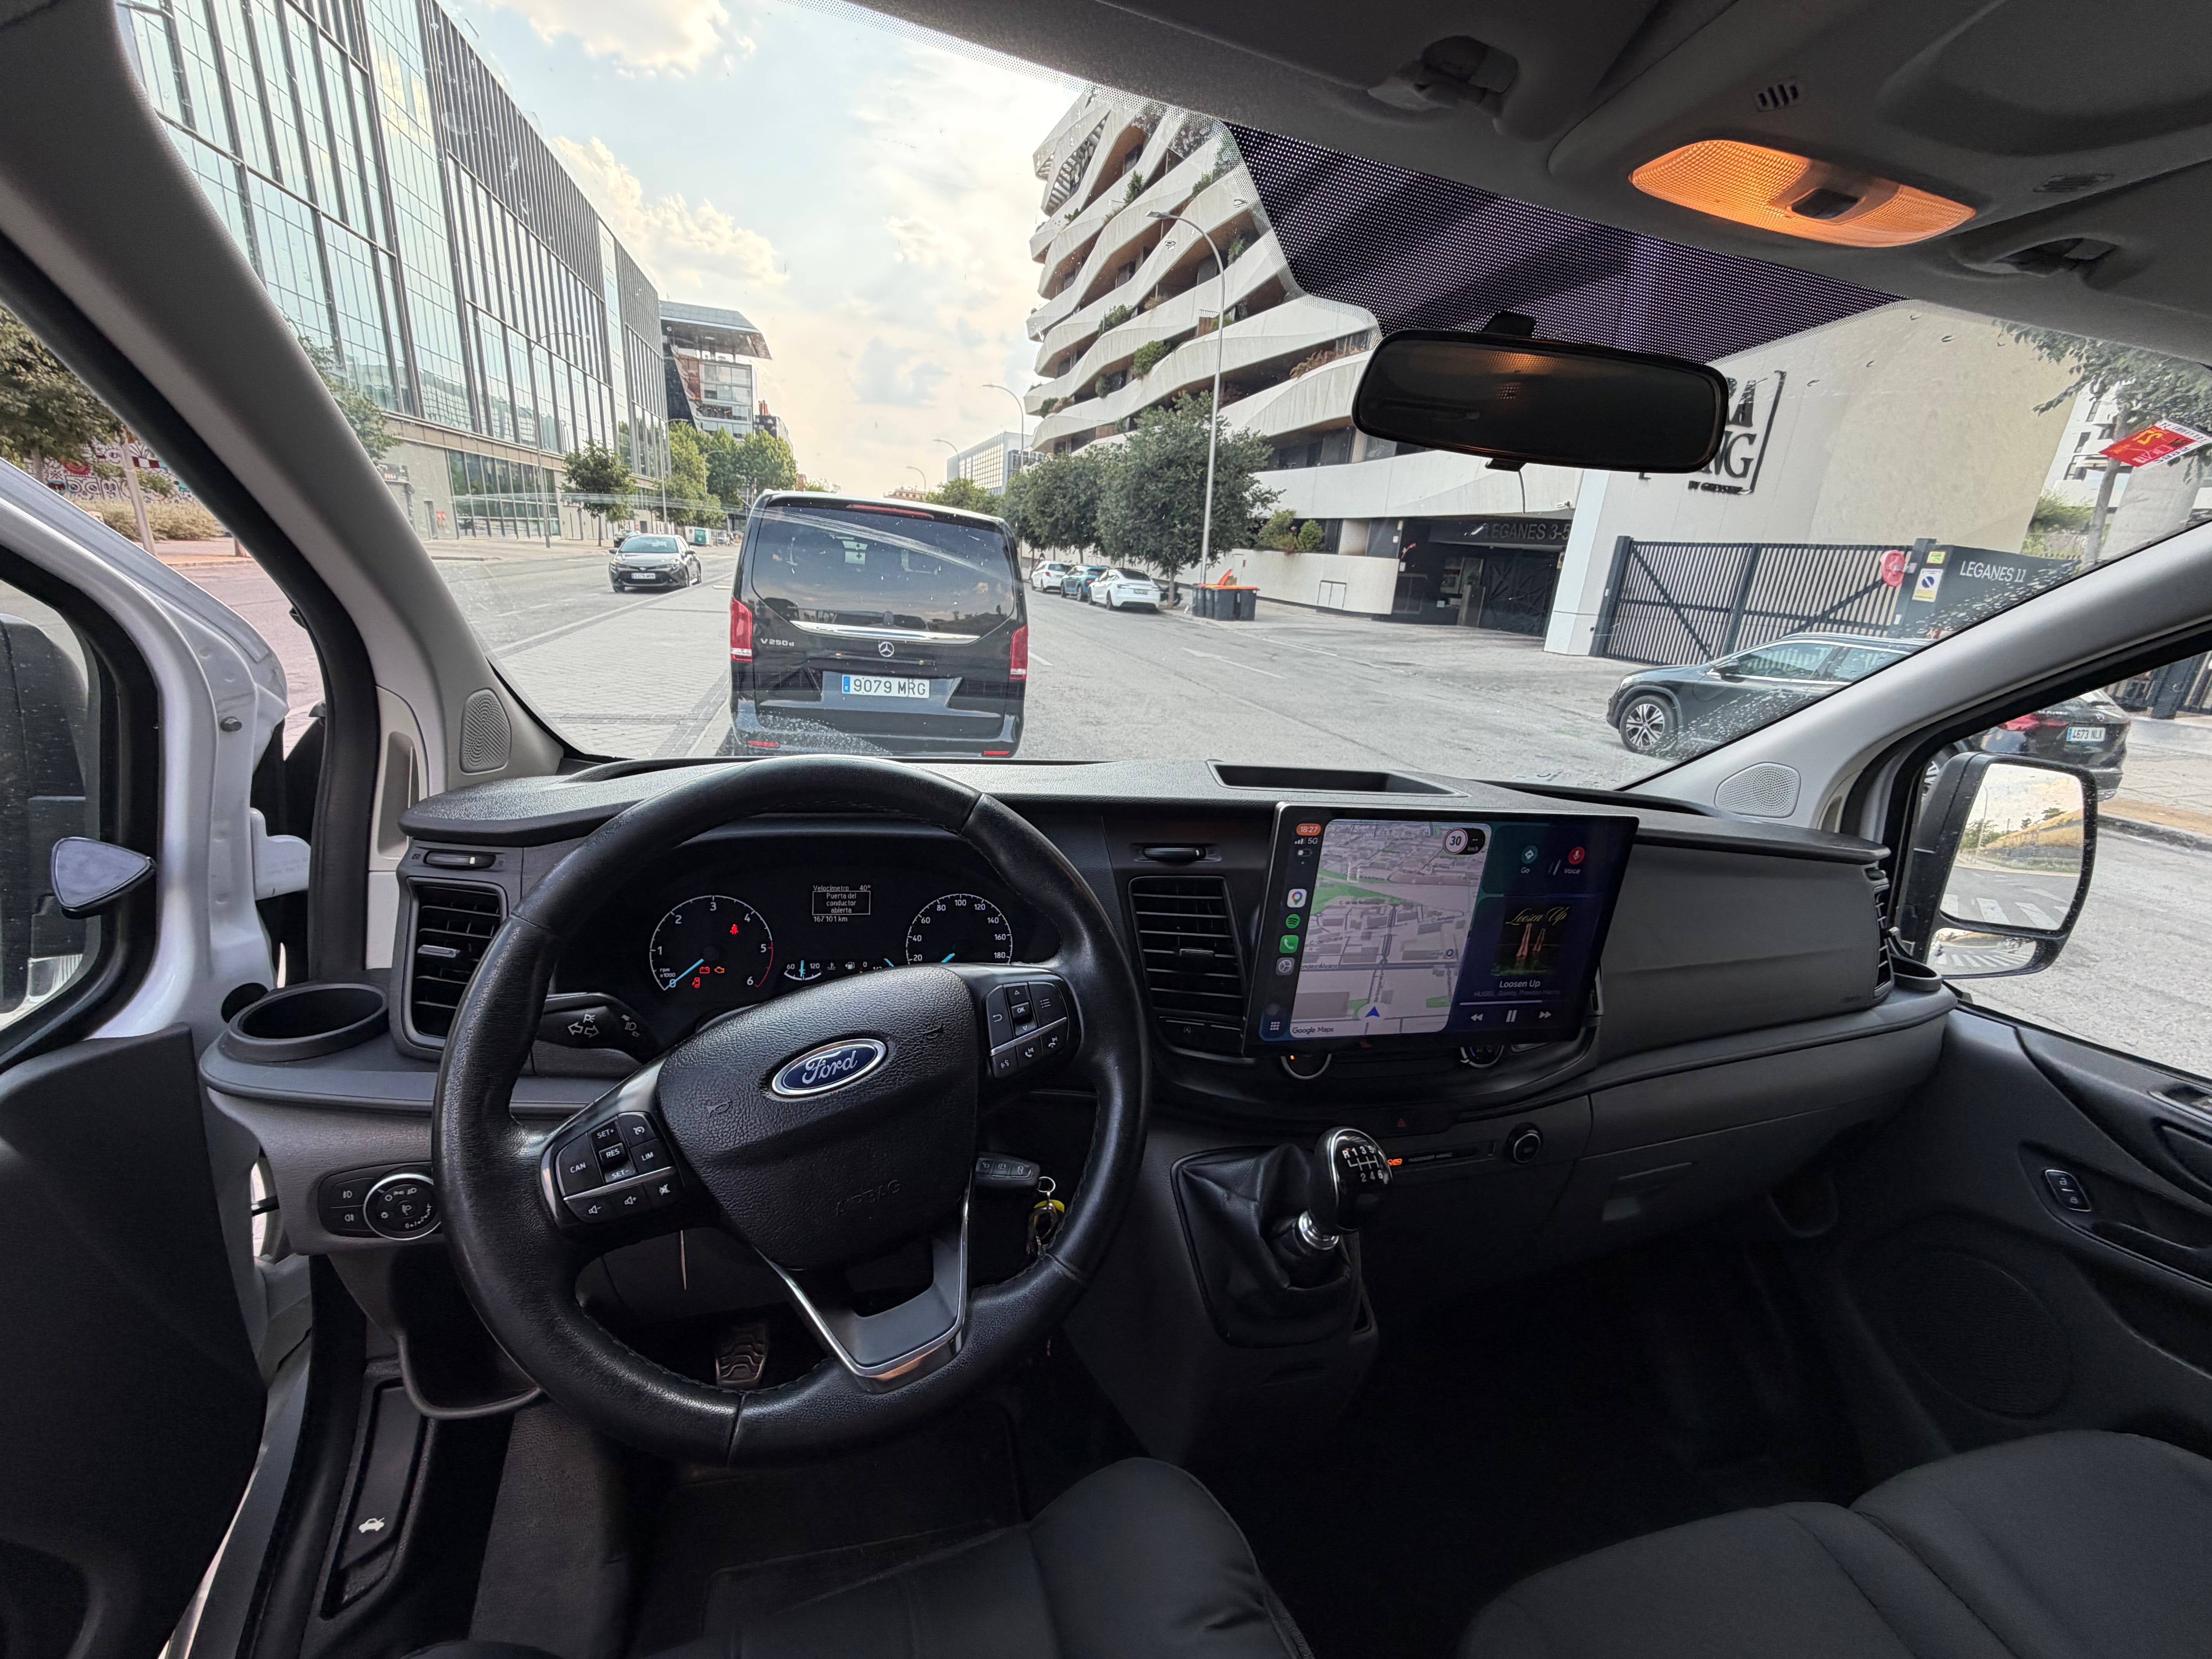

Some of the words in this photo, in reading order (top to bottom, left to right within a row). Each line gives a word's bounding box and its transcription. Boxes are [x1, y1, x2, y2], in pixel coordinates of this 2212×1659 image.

[1960, 560, 2014, 582] LEGANES
[854, 678, 891, 694] 9079
[898, 681, 926, 695] MRG
[2072, 729, 2090, 739] 4673
[1449, 836, 1462, 847] 30
[710, 902, 716, 911] 3
[675, 915, 682, 924] 2
[744, 913, 751, 922] 4
[657, 946, 662, 955] 1
[760, 943, 767, 953] 5
[747, 976, 754, 986] 6
[1529, 979, 1541, 988] Up
[802, 1050, 858, 1084] Ford
[597, 1128, 614, 1139] SET+
[606, 1149, 620, 1159] RES
[641, 1152, 654, 1161] LIM
[1342, 1150, 1350, 1159] R
[1352, 1147, 1358, 1156] 1
[1359, 1146, 1367, 1154] 3
[570, 1162, 586, 1173] CAN
[1360, 1173, 1367, 1182] 2
[1370, 1171, 1376, 1180] 4
[1377, 1170, 1383, 1179] 6
